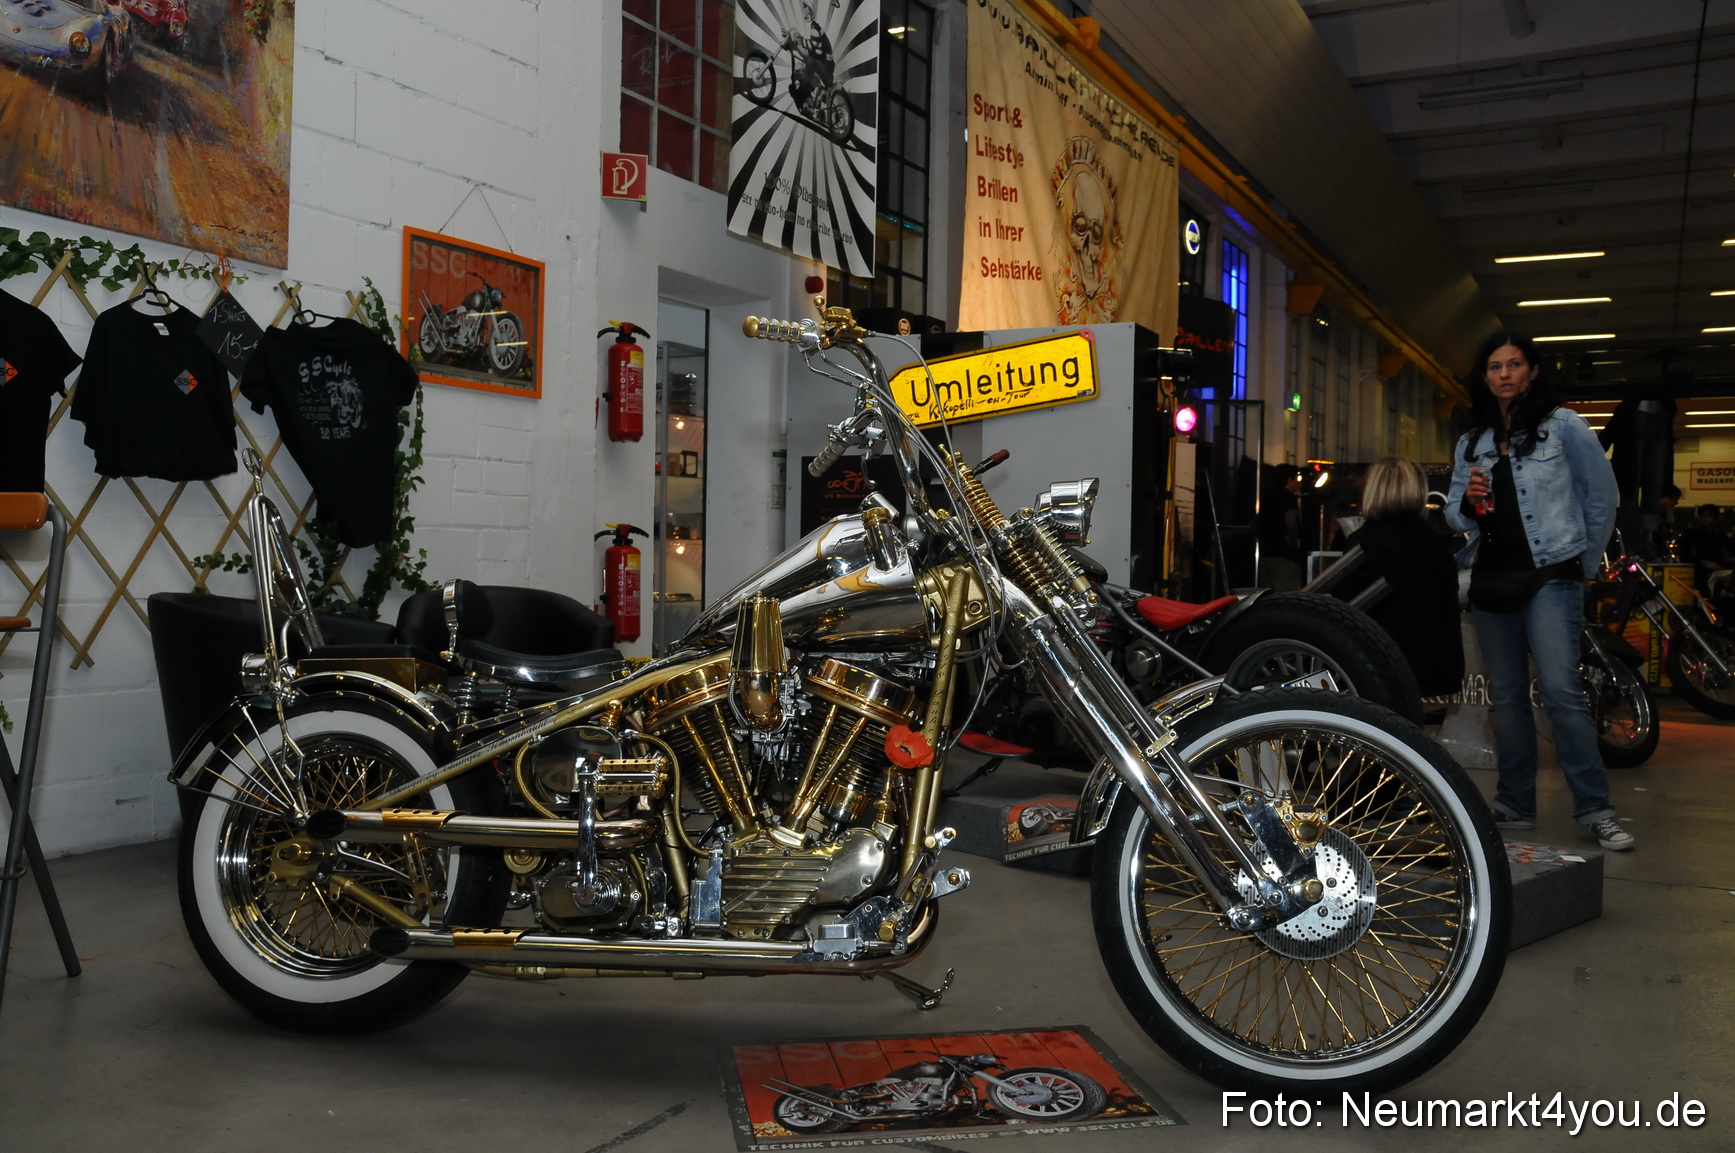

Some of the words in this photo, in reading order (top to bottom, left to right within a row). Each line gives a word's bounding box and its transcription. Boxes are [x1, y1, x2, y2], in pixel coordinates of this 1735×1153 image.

[1011, 107, 1023, 129] &
[977, 175, 1018, 203] Brillen
[978, 216, 992, 238] in
[995, 217, 1024, 242] Ihrer
[412, 240, 467, 278] SSC
[980, 255, 1042, 281] Sehstärke
[176, 377, 197, 386] SSC
[911, 356, 1081, 407] Umleitung
[1004, 849, 1033, 861] TECHNIK
[747, 1141, 825, 1151] TECHNIK
[871, 1131, 989, 1145] CUSTOMBIKES
